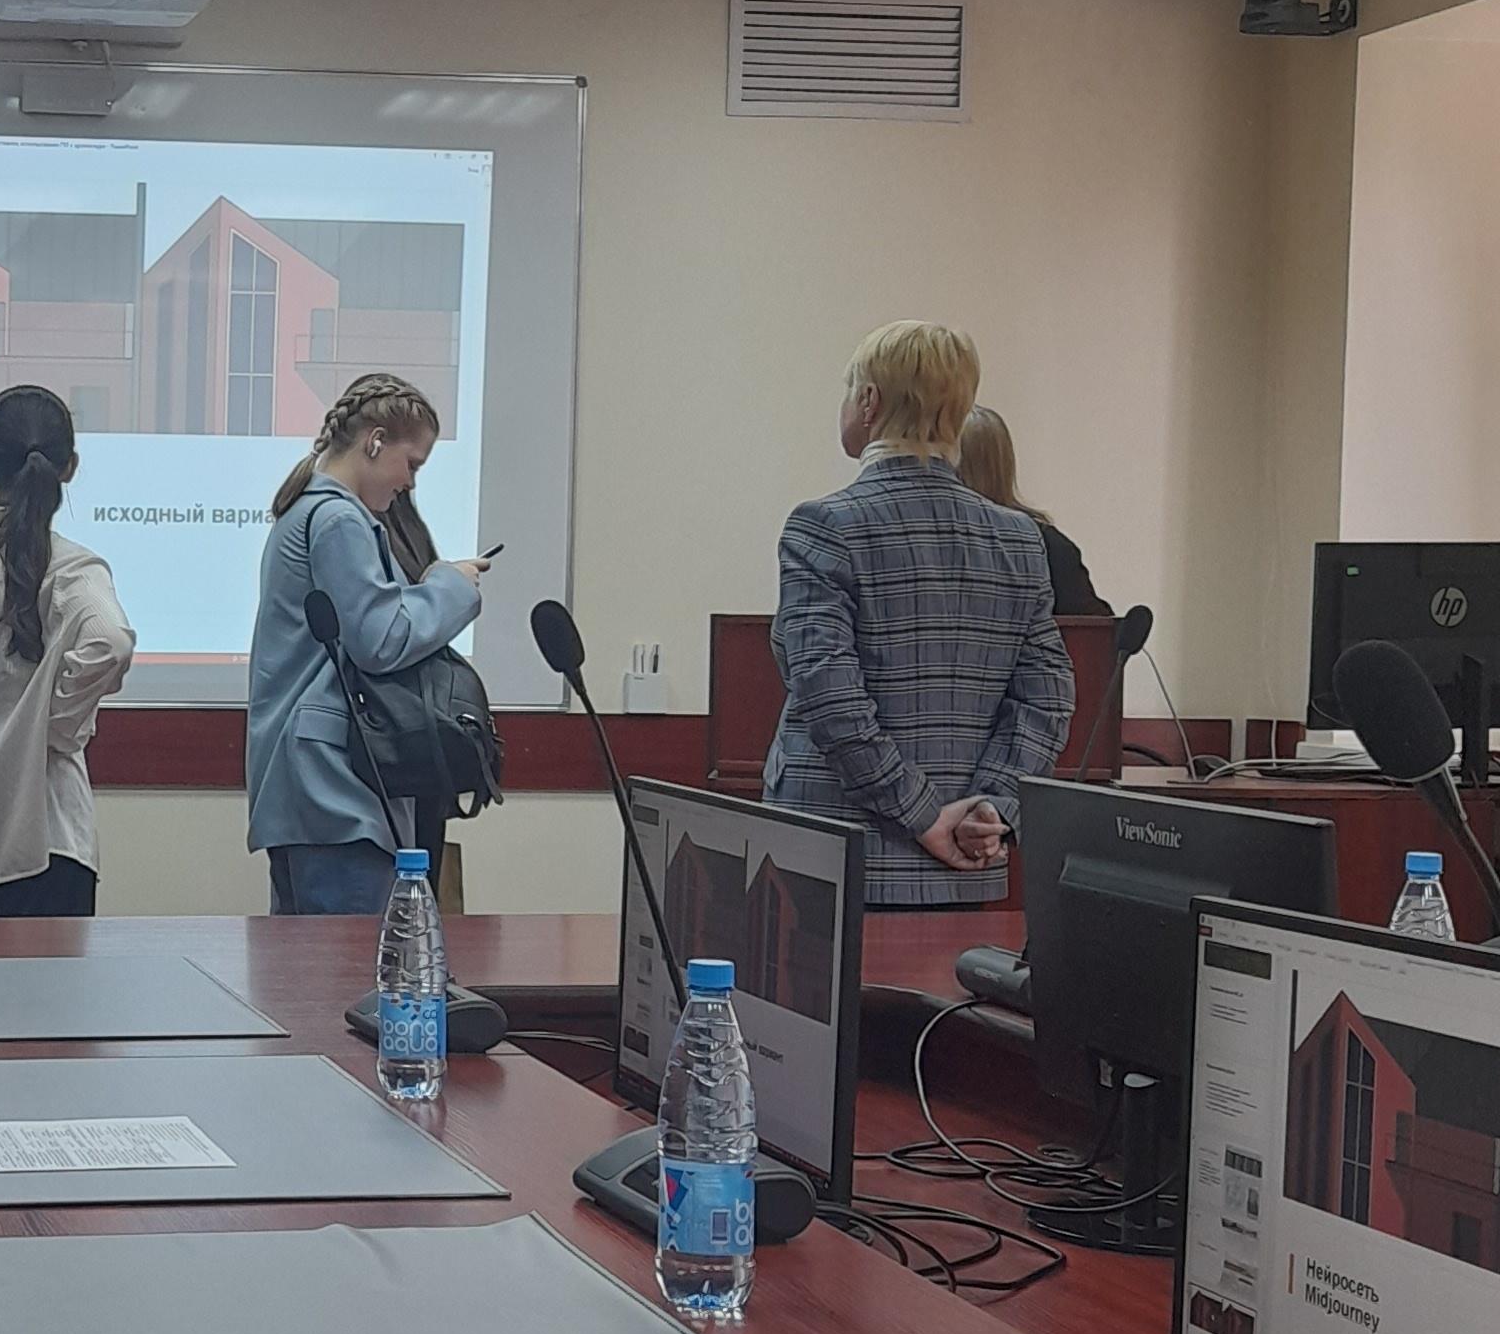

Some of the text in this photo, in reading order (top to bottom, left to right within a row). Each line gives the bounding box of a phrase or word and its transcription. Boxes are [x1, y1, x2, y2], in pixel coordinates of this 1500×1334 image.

[93, 503, 276, 529] исходный вариа
[1433, 586, 1465, 626] hp
[1115, 816, 1182, 848] ViewSonic
[1305, 1257, 1380, 1303] Нейросеть
[1304, 1283, 1380, 1334] Midjourney
